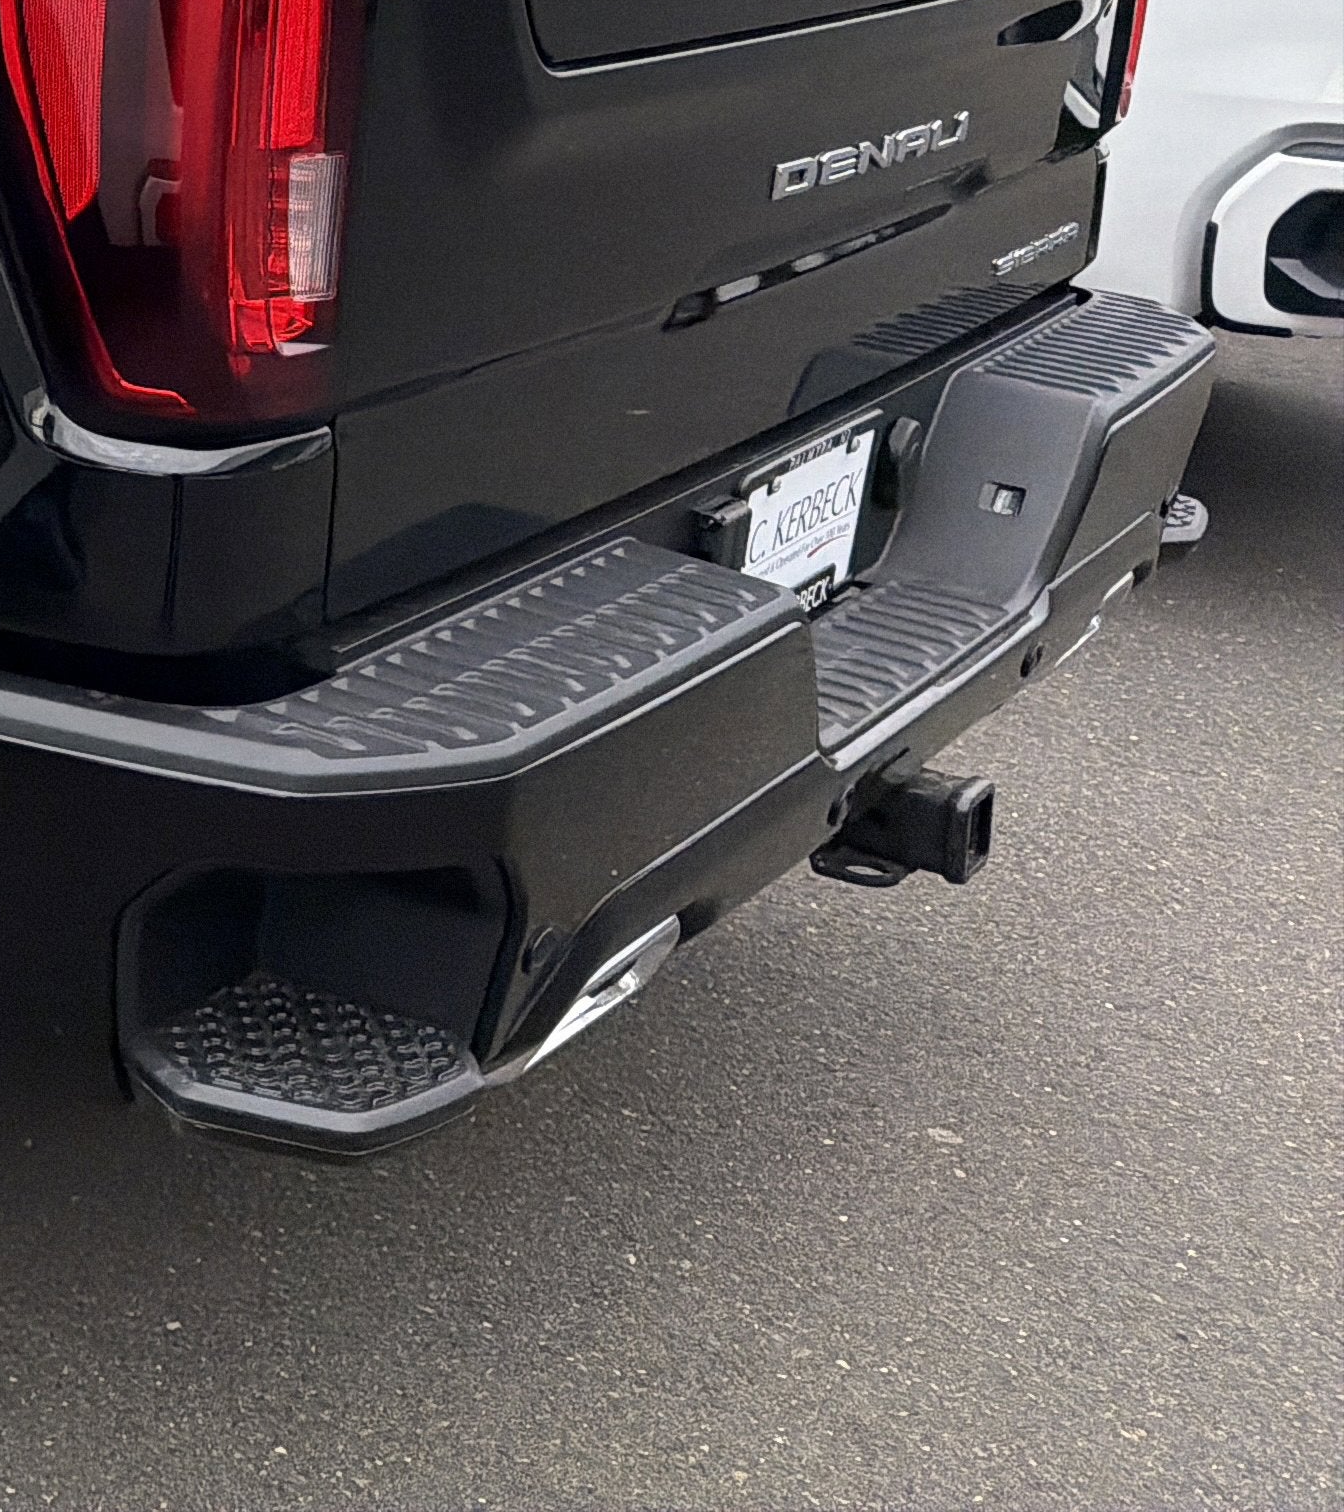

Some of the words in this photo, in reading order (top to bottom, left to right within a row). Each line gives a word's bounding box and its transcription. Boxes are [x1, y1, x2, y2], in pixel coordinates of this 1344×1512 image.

[770, 110, 970, 201] DENALI
[991, 221, 1080, 276] SIERRA
[772, 467, 864, 551] KERBECK
